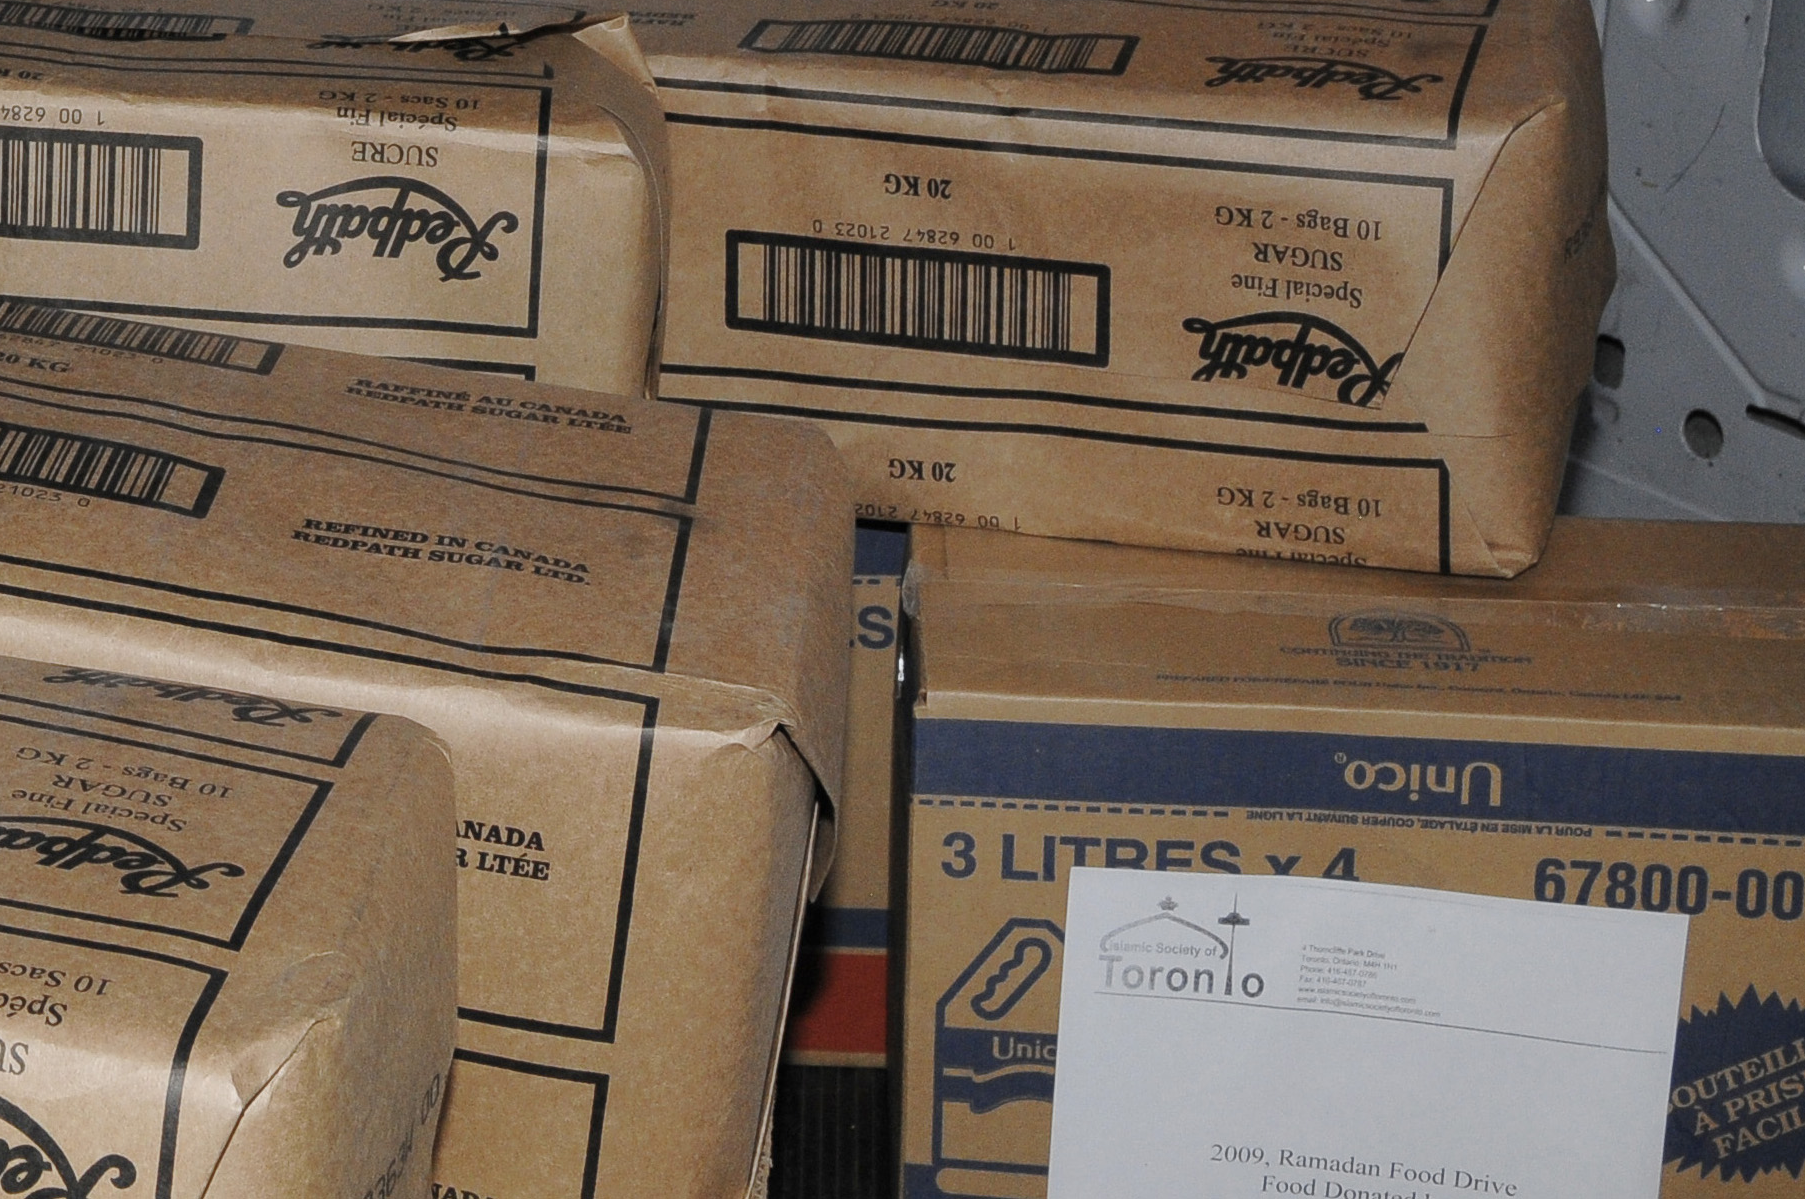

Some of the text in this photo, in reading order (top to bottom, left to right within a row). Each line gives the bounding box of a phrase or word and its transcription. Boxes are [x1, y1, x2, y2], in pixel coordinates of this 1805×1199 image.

[1205, 55, 1445, 102] Redpath
[336, 106, 458, 133] Spécial Fin
[351, 140, 439, 167] SUCRE
[883, 172, 953, 199] 20 KG
[276, 175, 520, 283] Redpath
[1252, 242, 1344, 272] SUGAR
[1230, 272, 1363, 310] Special Fine
[1182, 311, 1405, 408] Redpath
[292, 529, 592, 587] REDPATH SUGAR LTD.
[303, 517, 591, 575] REFINED IN CANADA
[1280, 646, 1533, 665] CONTINUING THE TRADITION
[1336, 657, 1480, 672] SINCE 1917
[1344, 759, 1502, 807] Unico
[1246, 809, 1283, 821] LIGNE
[1286, 811, 1304, 822] LA
[1305, 812, 1360, 826] SUIVANT
[1361, 815, 1415, 829] COUPER
[1481, 822, 1499, 834] EN
[1501, 823, 1532, 836] MISE
[1534, 825, 1554, 837] LA
[1554, 826, 1594, 839] POUR
[476, 852, 551, 882] LTÉE
[941, 831, 978, 879] 3
[1321, 846, 1360, 882] 4
[1109, 940, 1218, 958] Islamic Society of
[1347, 947, 1365, 957] Park
[1366, 949, 1386, 959] Drive
[1667, 1037, 1805, 1116] OUTEIL
[1693, 1068, 1805, 1137] À PRIS
[1210, 1143, 1518, 1197] 2009, Ramadan Food Drive
[1260, 1175, 1316, 1197] Food
